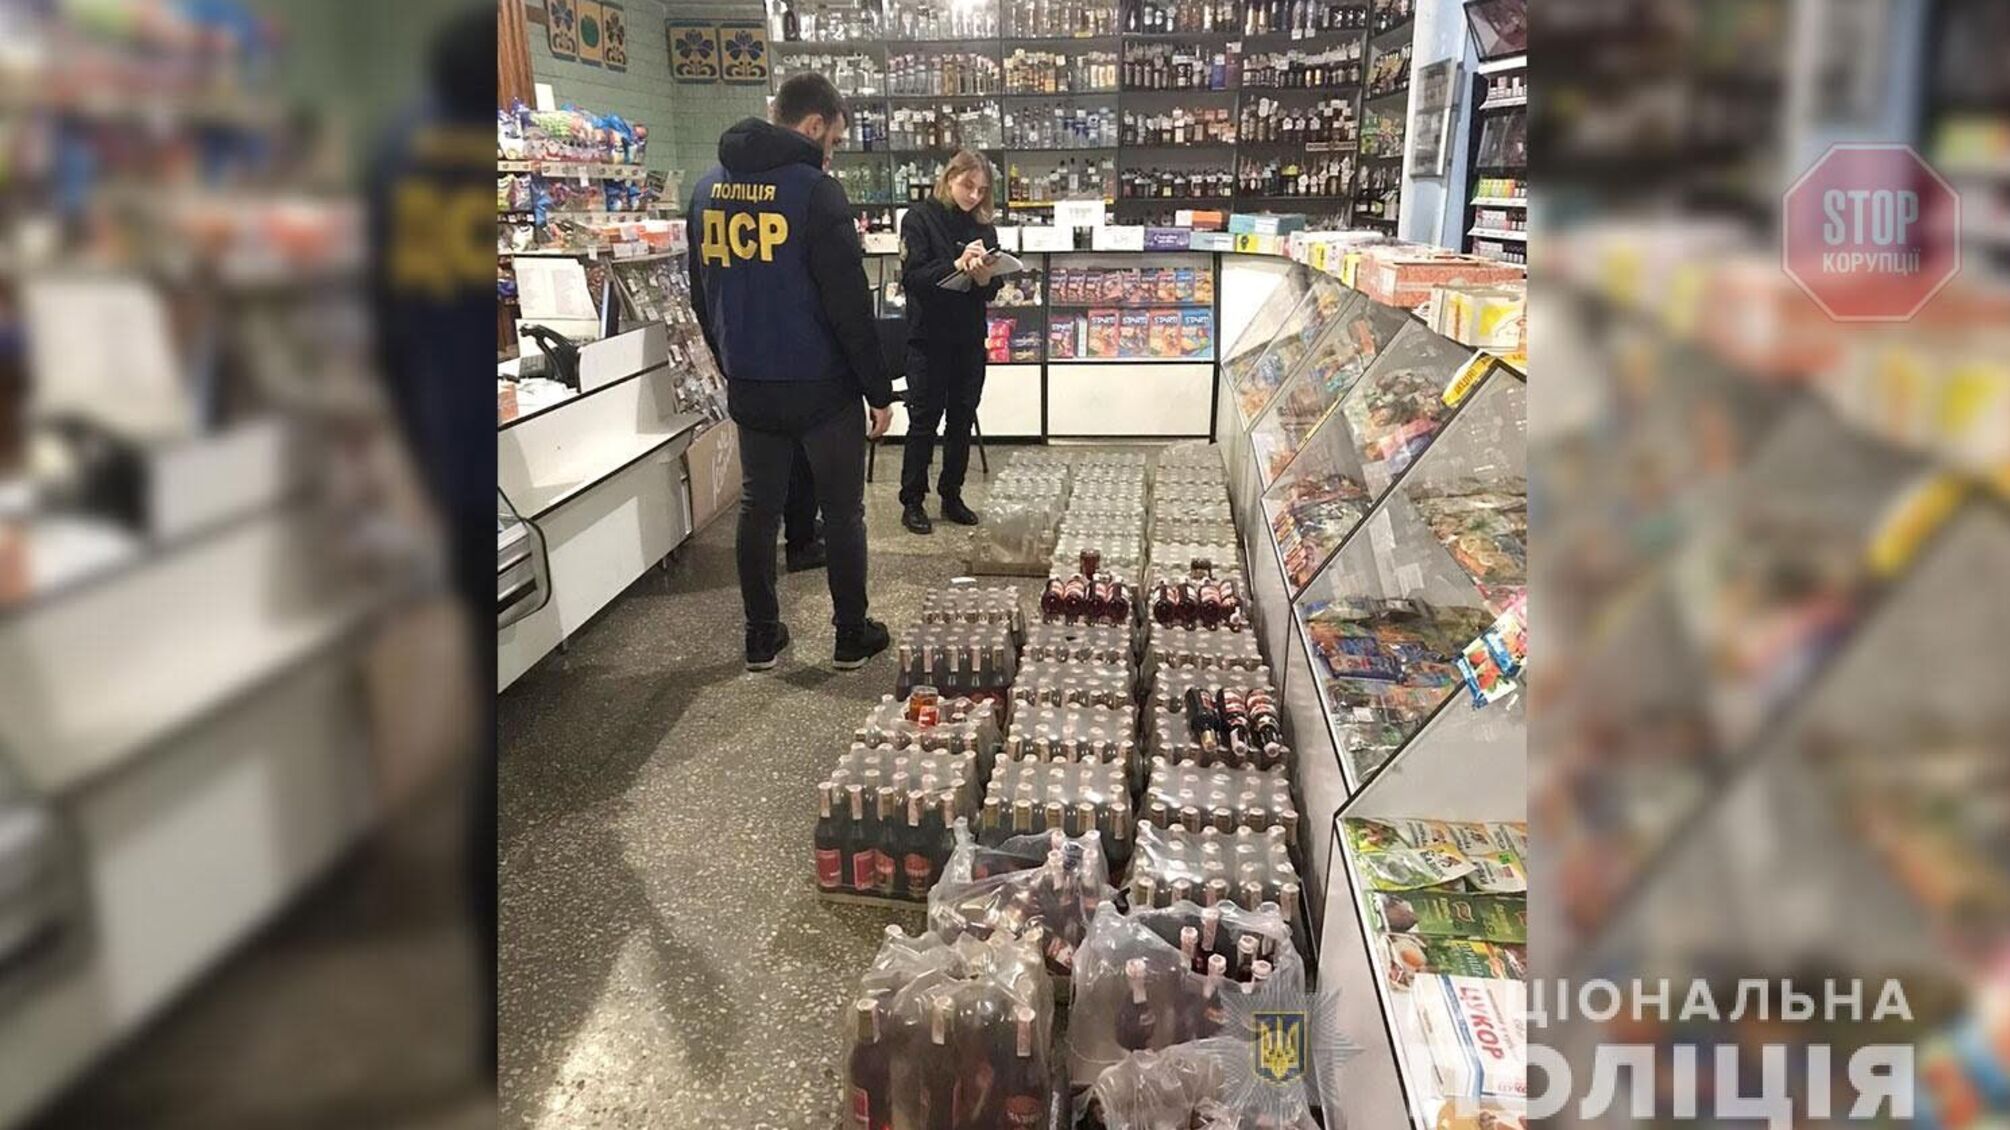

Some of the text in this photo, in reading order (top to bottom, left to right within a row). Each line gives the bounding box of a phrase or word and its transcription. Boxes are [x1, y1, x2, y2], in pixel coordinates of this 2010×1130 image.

[711, 182, 777, 203] ПОЛІЦІЯ
[701, 209, 789, 268] ДСР
[1459, 986, 1505, 1060] ЦУКОР
